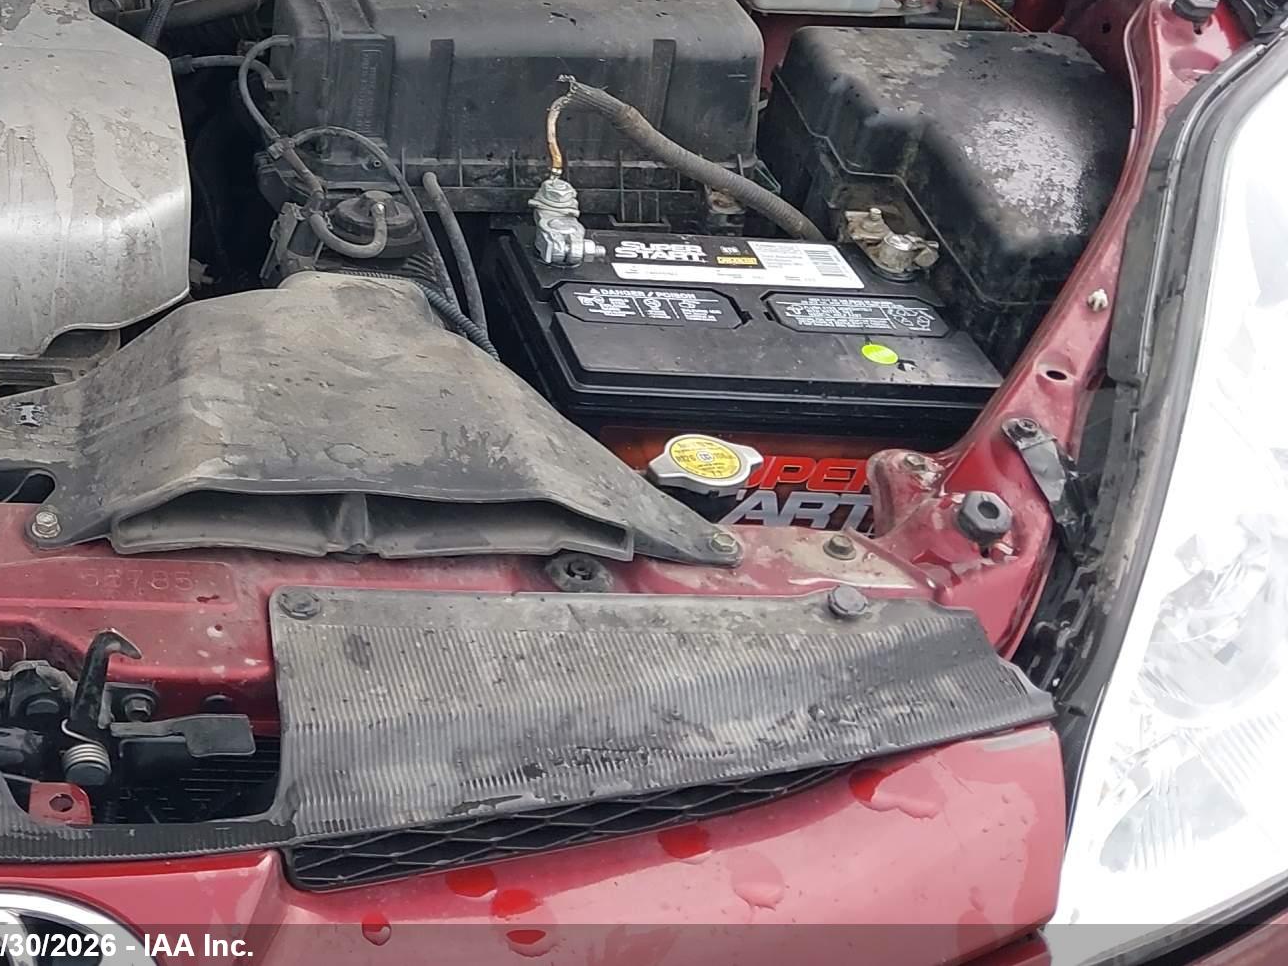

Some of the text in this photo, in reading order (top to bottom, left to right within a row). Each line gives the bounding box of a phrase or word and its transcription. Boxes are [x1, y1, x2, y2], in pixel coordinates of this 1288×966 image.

[620, 240, 703, 254] SUPER
[600, 288, 646, 297] DANGER
[655, 290, 697, 300] POISON
